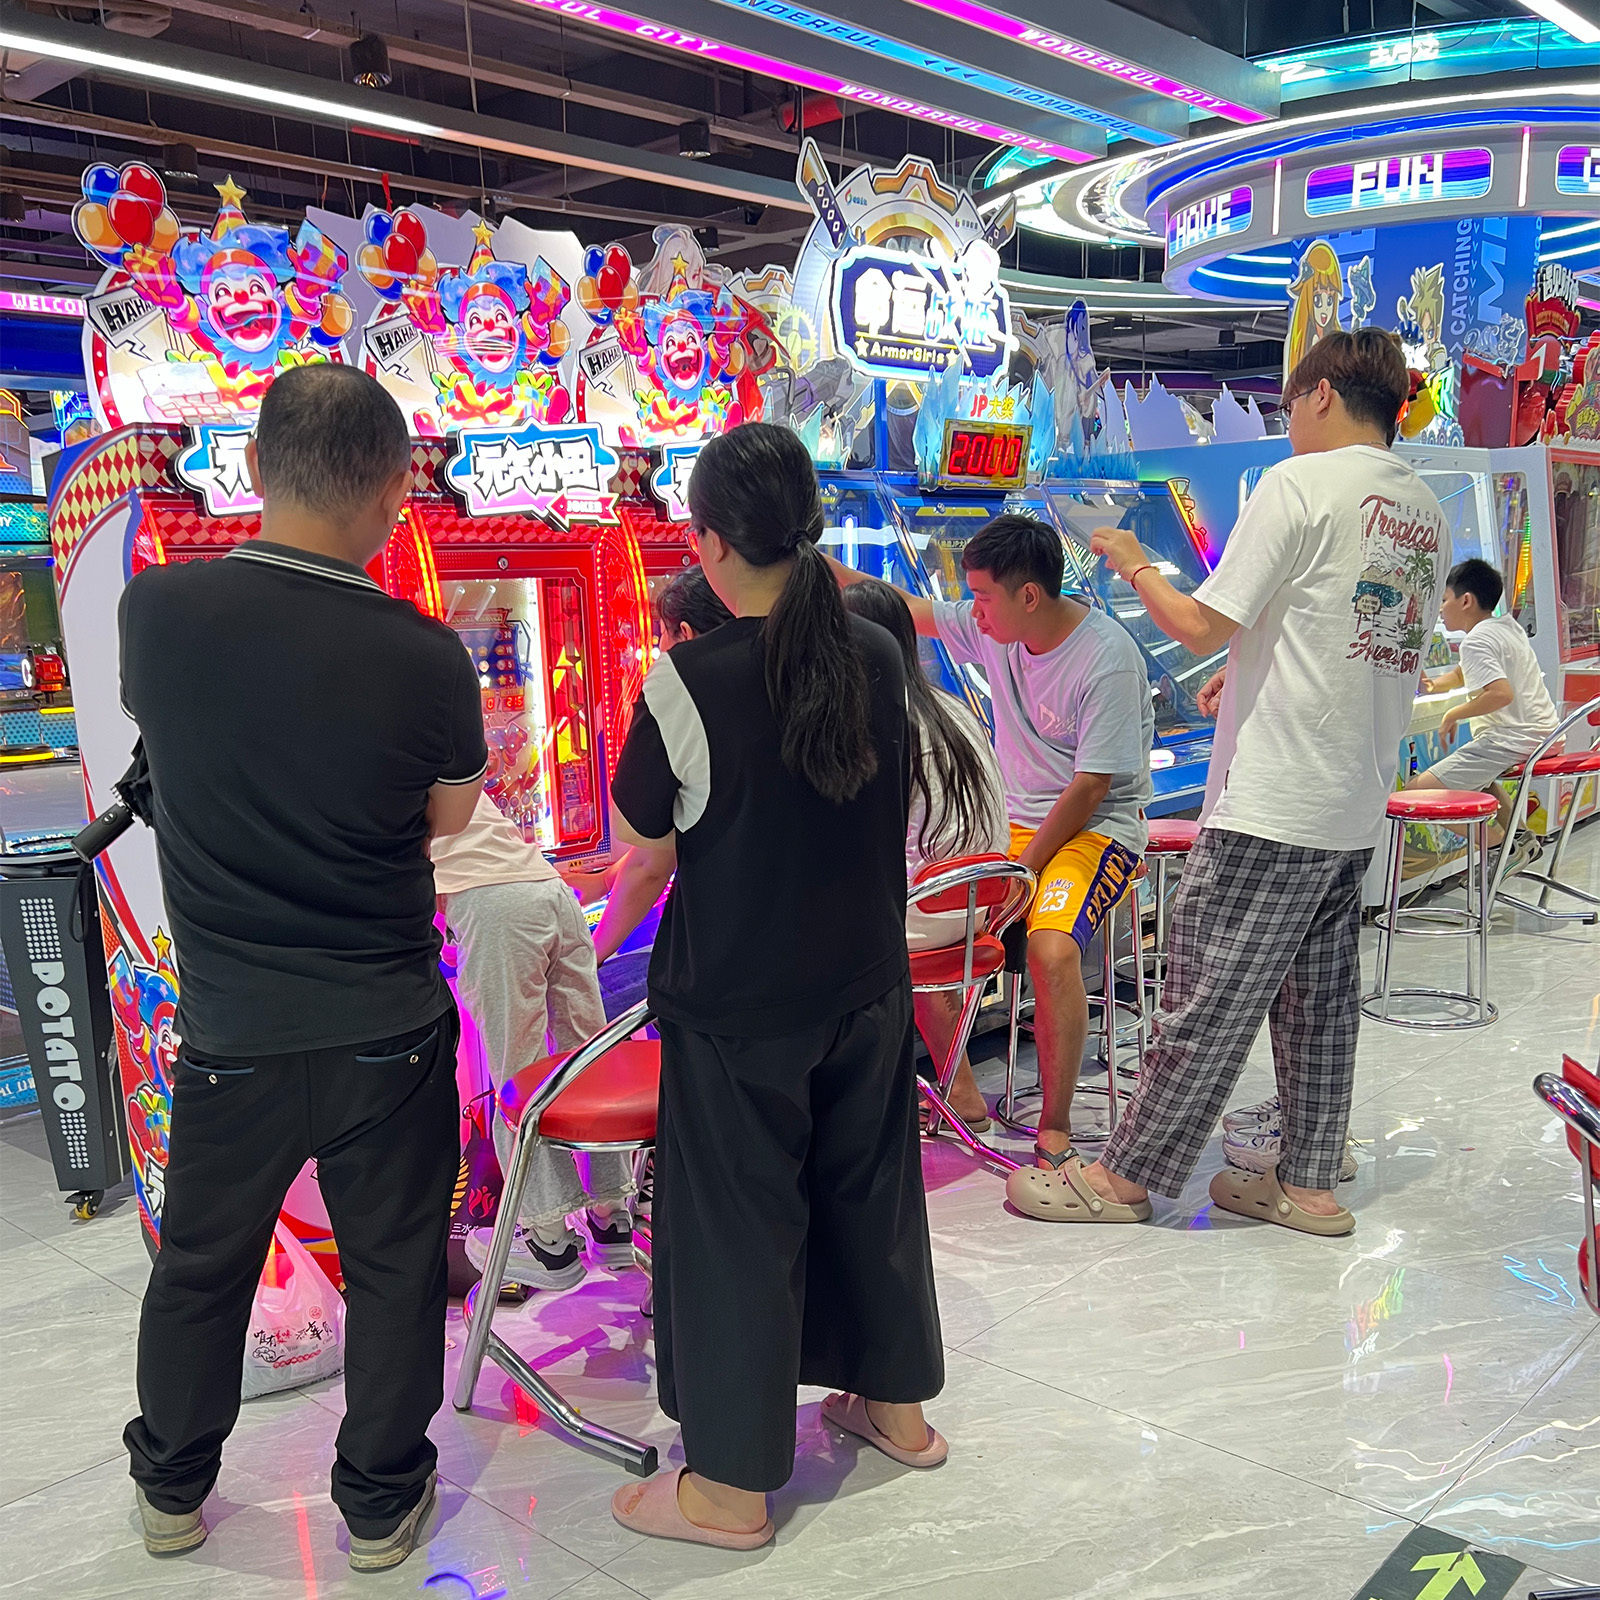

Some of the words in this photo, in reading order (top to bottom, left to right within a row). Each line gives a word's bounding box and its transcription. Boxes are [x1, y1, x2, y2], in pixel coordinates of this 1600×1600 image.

[635, 25, 719, 51] CITY
[739, 0, 882, 47] NDERFUL
[1018, 28, 1160, 86] WONDERFUL
[1172, 88, 1227, 109] CITY
[838, 84, 984, 131] WONDERFUL
[998, 131, 1053, 150] CITY
[1007, 87, 1136, 132] WONDERFUL
[1351, 153, 1443, 206] FUN
[1176, 192, 1231, 251] HAVE
[1450, 218, 1473, 335] CATCHING
[869, 341, 945, 364] ArmorGirls
[970, 394, 1015, 420] JP大奖
[949, 433, 1022, 475] 2000
[567, 500, 602, 513] JOKER
[1359, 494, 1441, 553] Tropical
[1396, 501, 1438, 524] BEACH
[1038, 890, 1070, 914] 23
[1086, 853, 1126, 930] LAKERS
[31, 961, 86, 1112] POTATO
